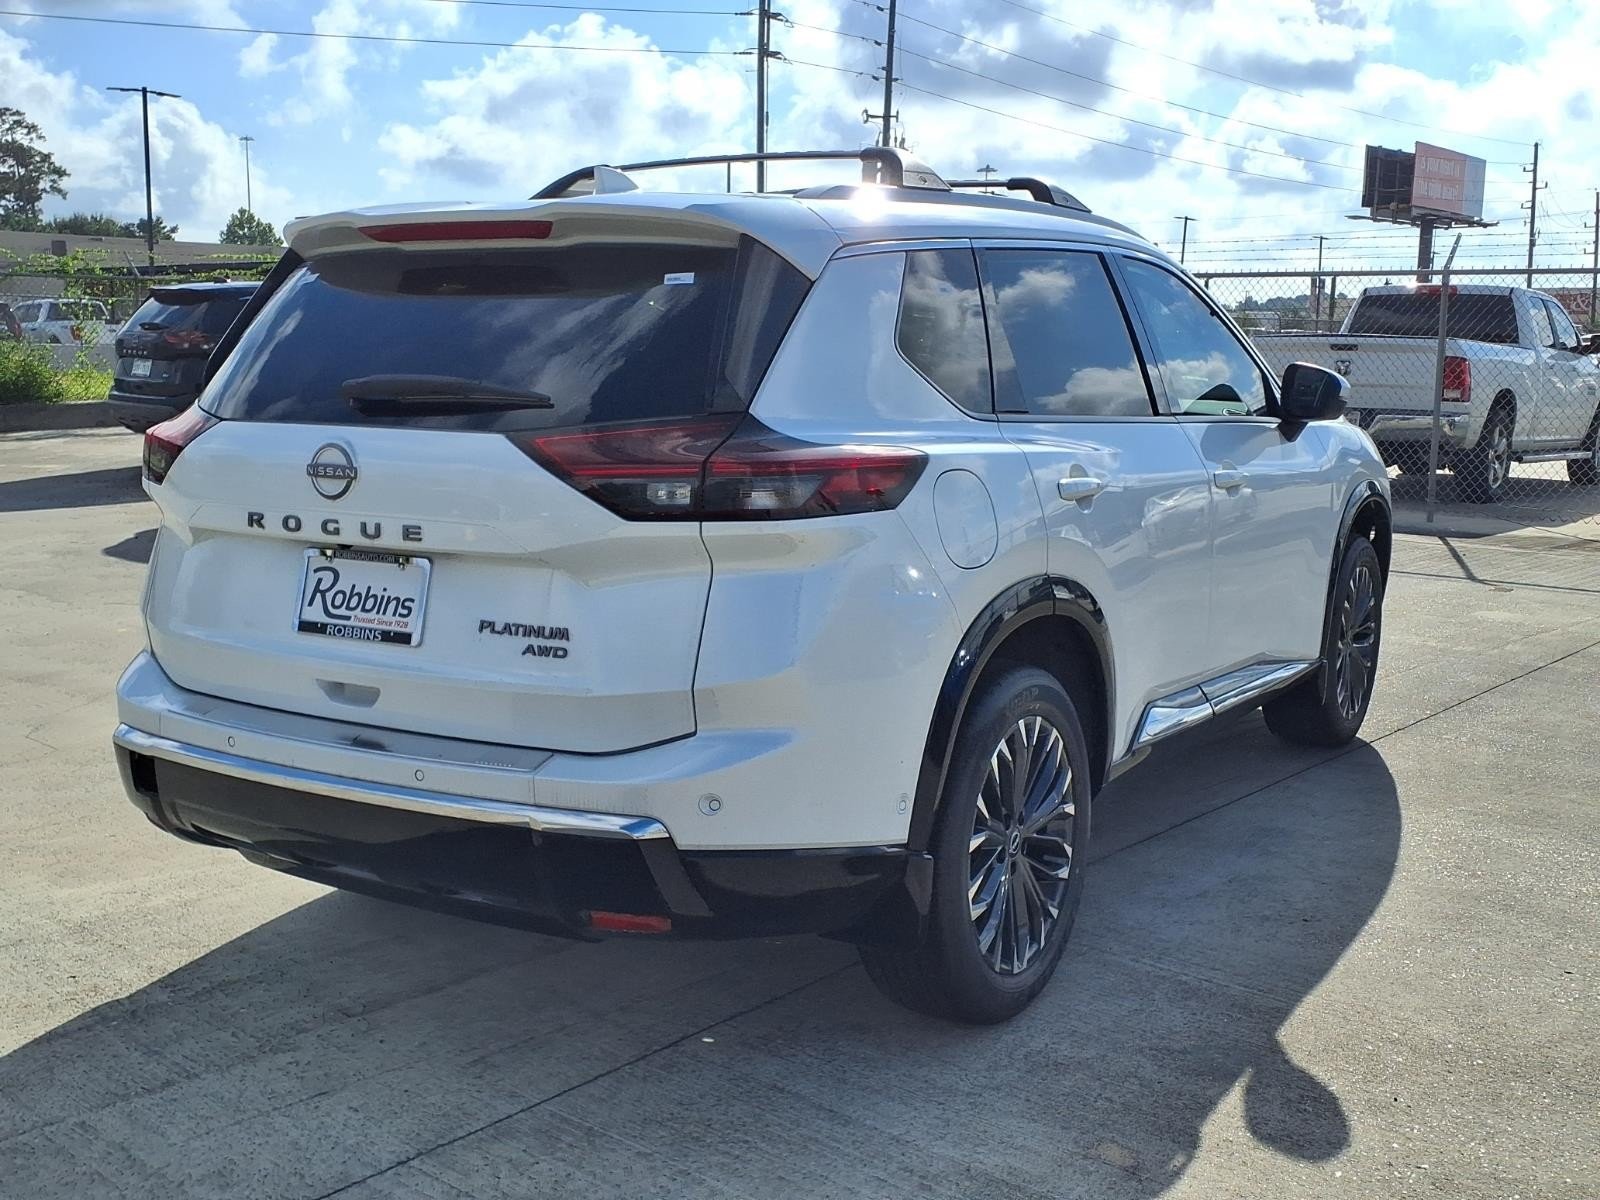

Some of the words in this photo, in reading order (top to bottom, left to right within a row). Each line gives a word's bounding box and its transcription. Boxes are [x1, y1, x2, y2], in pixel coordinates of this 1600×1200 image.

[308, 465, 354, 478] NISSAN
[247, 511, 423, 542] ROGUE
[307, 566, 416, 621] Robbins
[353, 615, 375, 625] Trusted
[376, 618, 393, 627] Since
[394, 620, 409, 629] 1928
[478, 619, 570, 642] PLATINUM
[326, 624, 382, 641] ROBBINS
[521, 644, 568, 659] AWD
